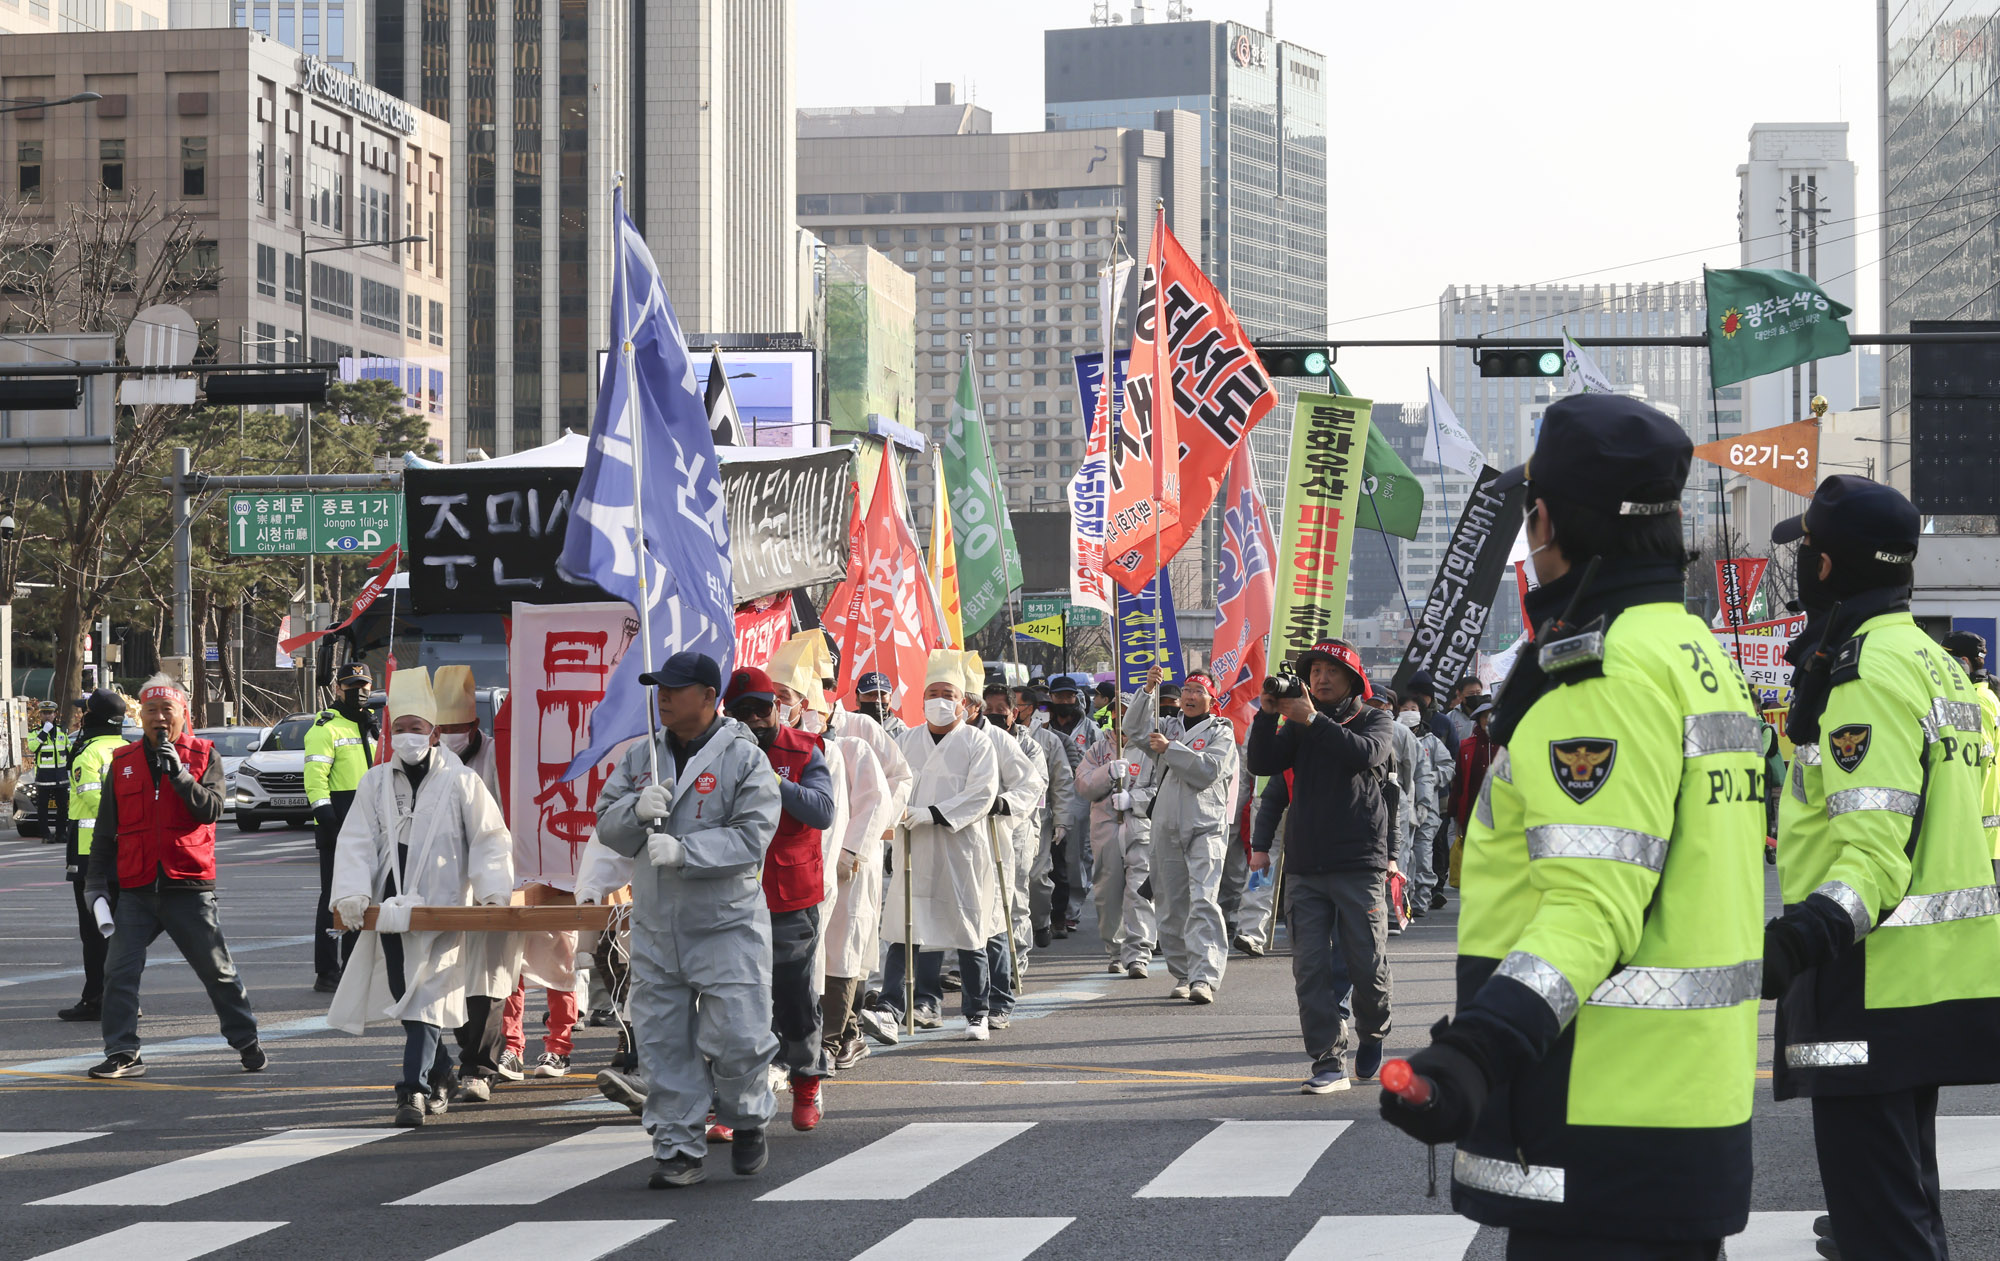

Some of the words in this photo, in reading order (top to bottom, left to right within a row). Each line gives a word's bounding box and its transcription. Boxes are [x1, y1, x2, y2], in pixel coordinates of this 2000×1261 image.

[1299, 405, 1356, 501] 문화유산
[1729, 443, 1809, 470] 62기-3
[237, 503, 248, 512] 60
[255, 497, 305, 513] 숭례문
[323, 517, 356, 529] Jongno
[359, 517, 389, 529] 1(il)-ga
[256, 527, 282, 542] 시청
[257, 542, 276, 552] City
[279, 542, 296, 550] Hall
[343, 538, 352, 549] 6
[1292, 504, 1345, 599] 파괴하는
[1028, 624, 1061, 635] 24기-1
[1120, 609, 1177, 685] 실천하라
[1188, 674, 1212, 687] 사반대
[1750, 670, 1777, 685] 주민
[122, 765, 134, 779] 투
[1567, 780, 1595, 790] POLICE
[696, 799, 704, 819] 1
